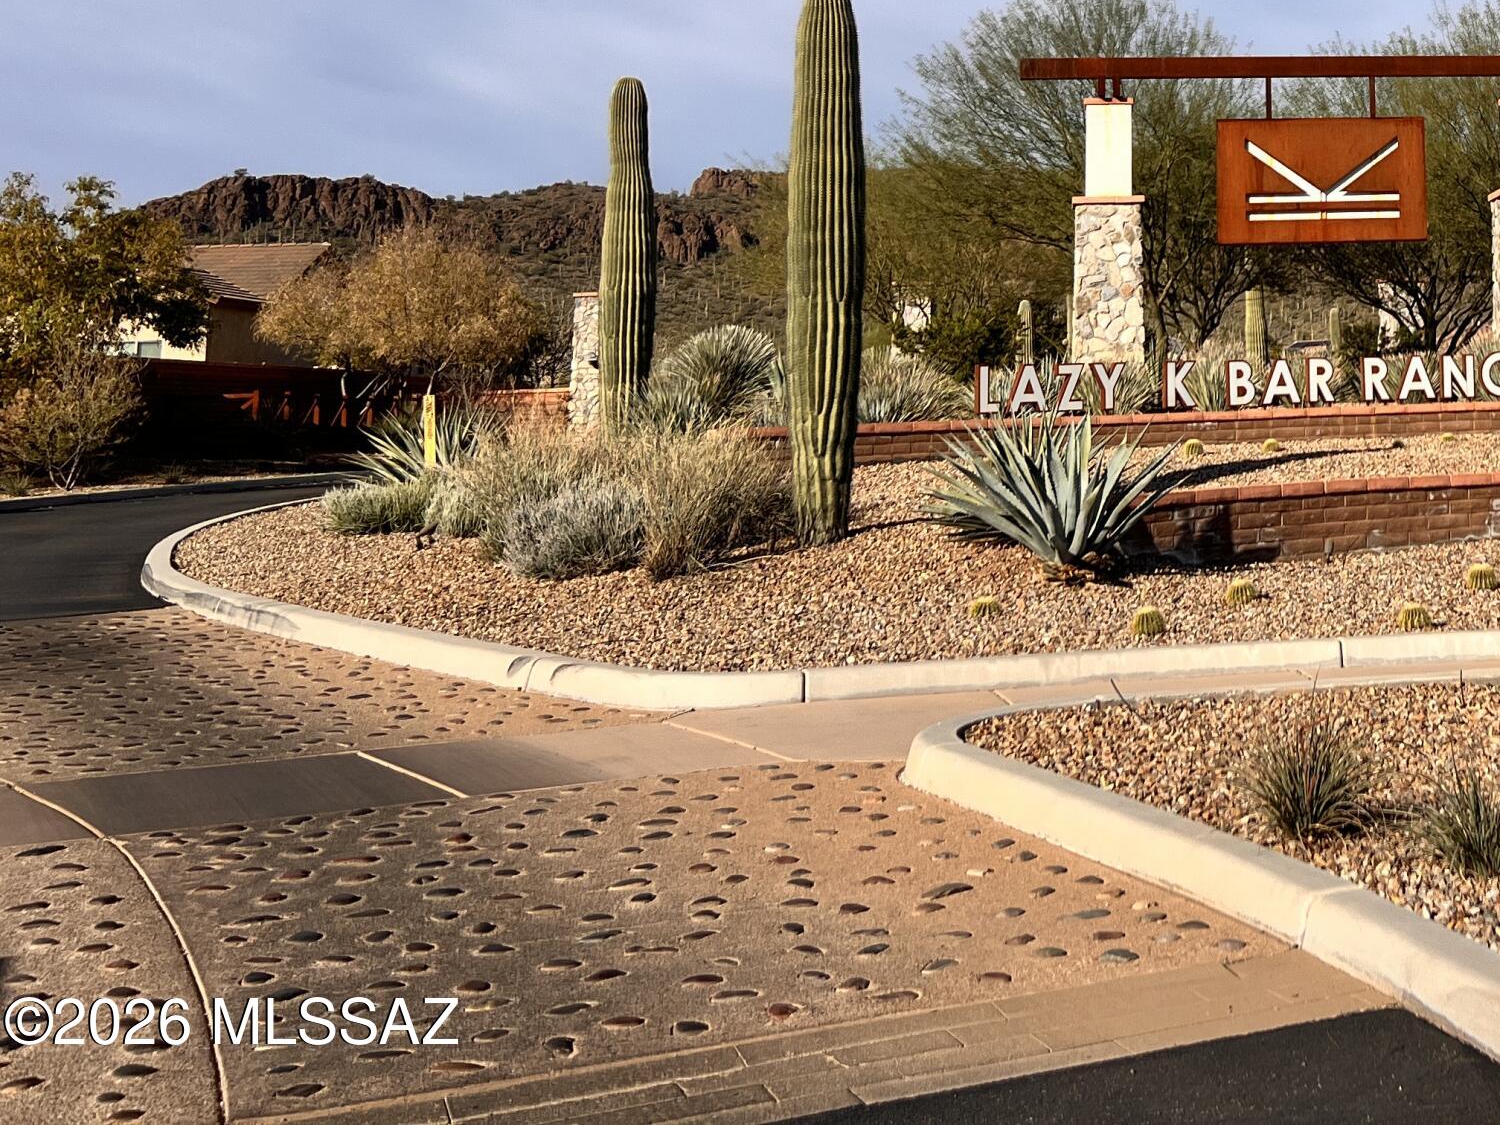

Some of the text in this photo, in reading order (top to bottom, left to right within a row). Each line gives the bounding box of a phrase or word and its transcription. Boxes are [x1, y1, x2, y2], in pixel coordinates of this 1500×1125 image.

[976, 362, 1125, 414] LAZY
[1163, 360, 1197, 409] K
[1227, 357, 1335, 406] BAR
